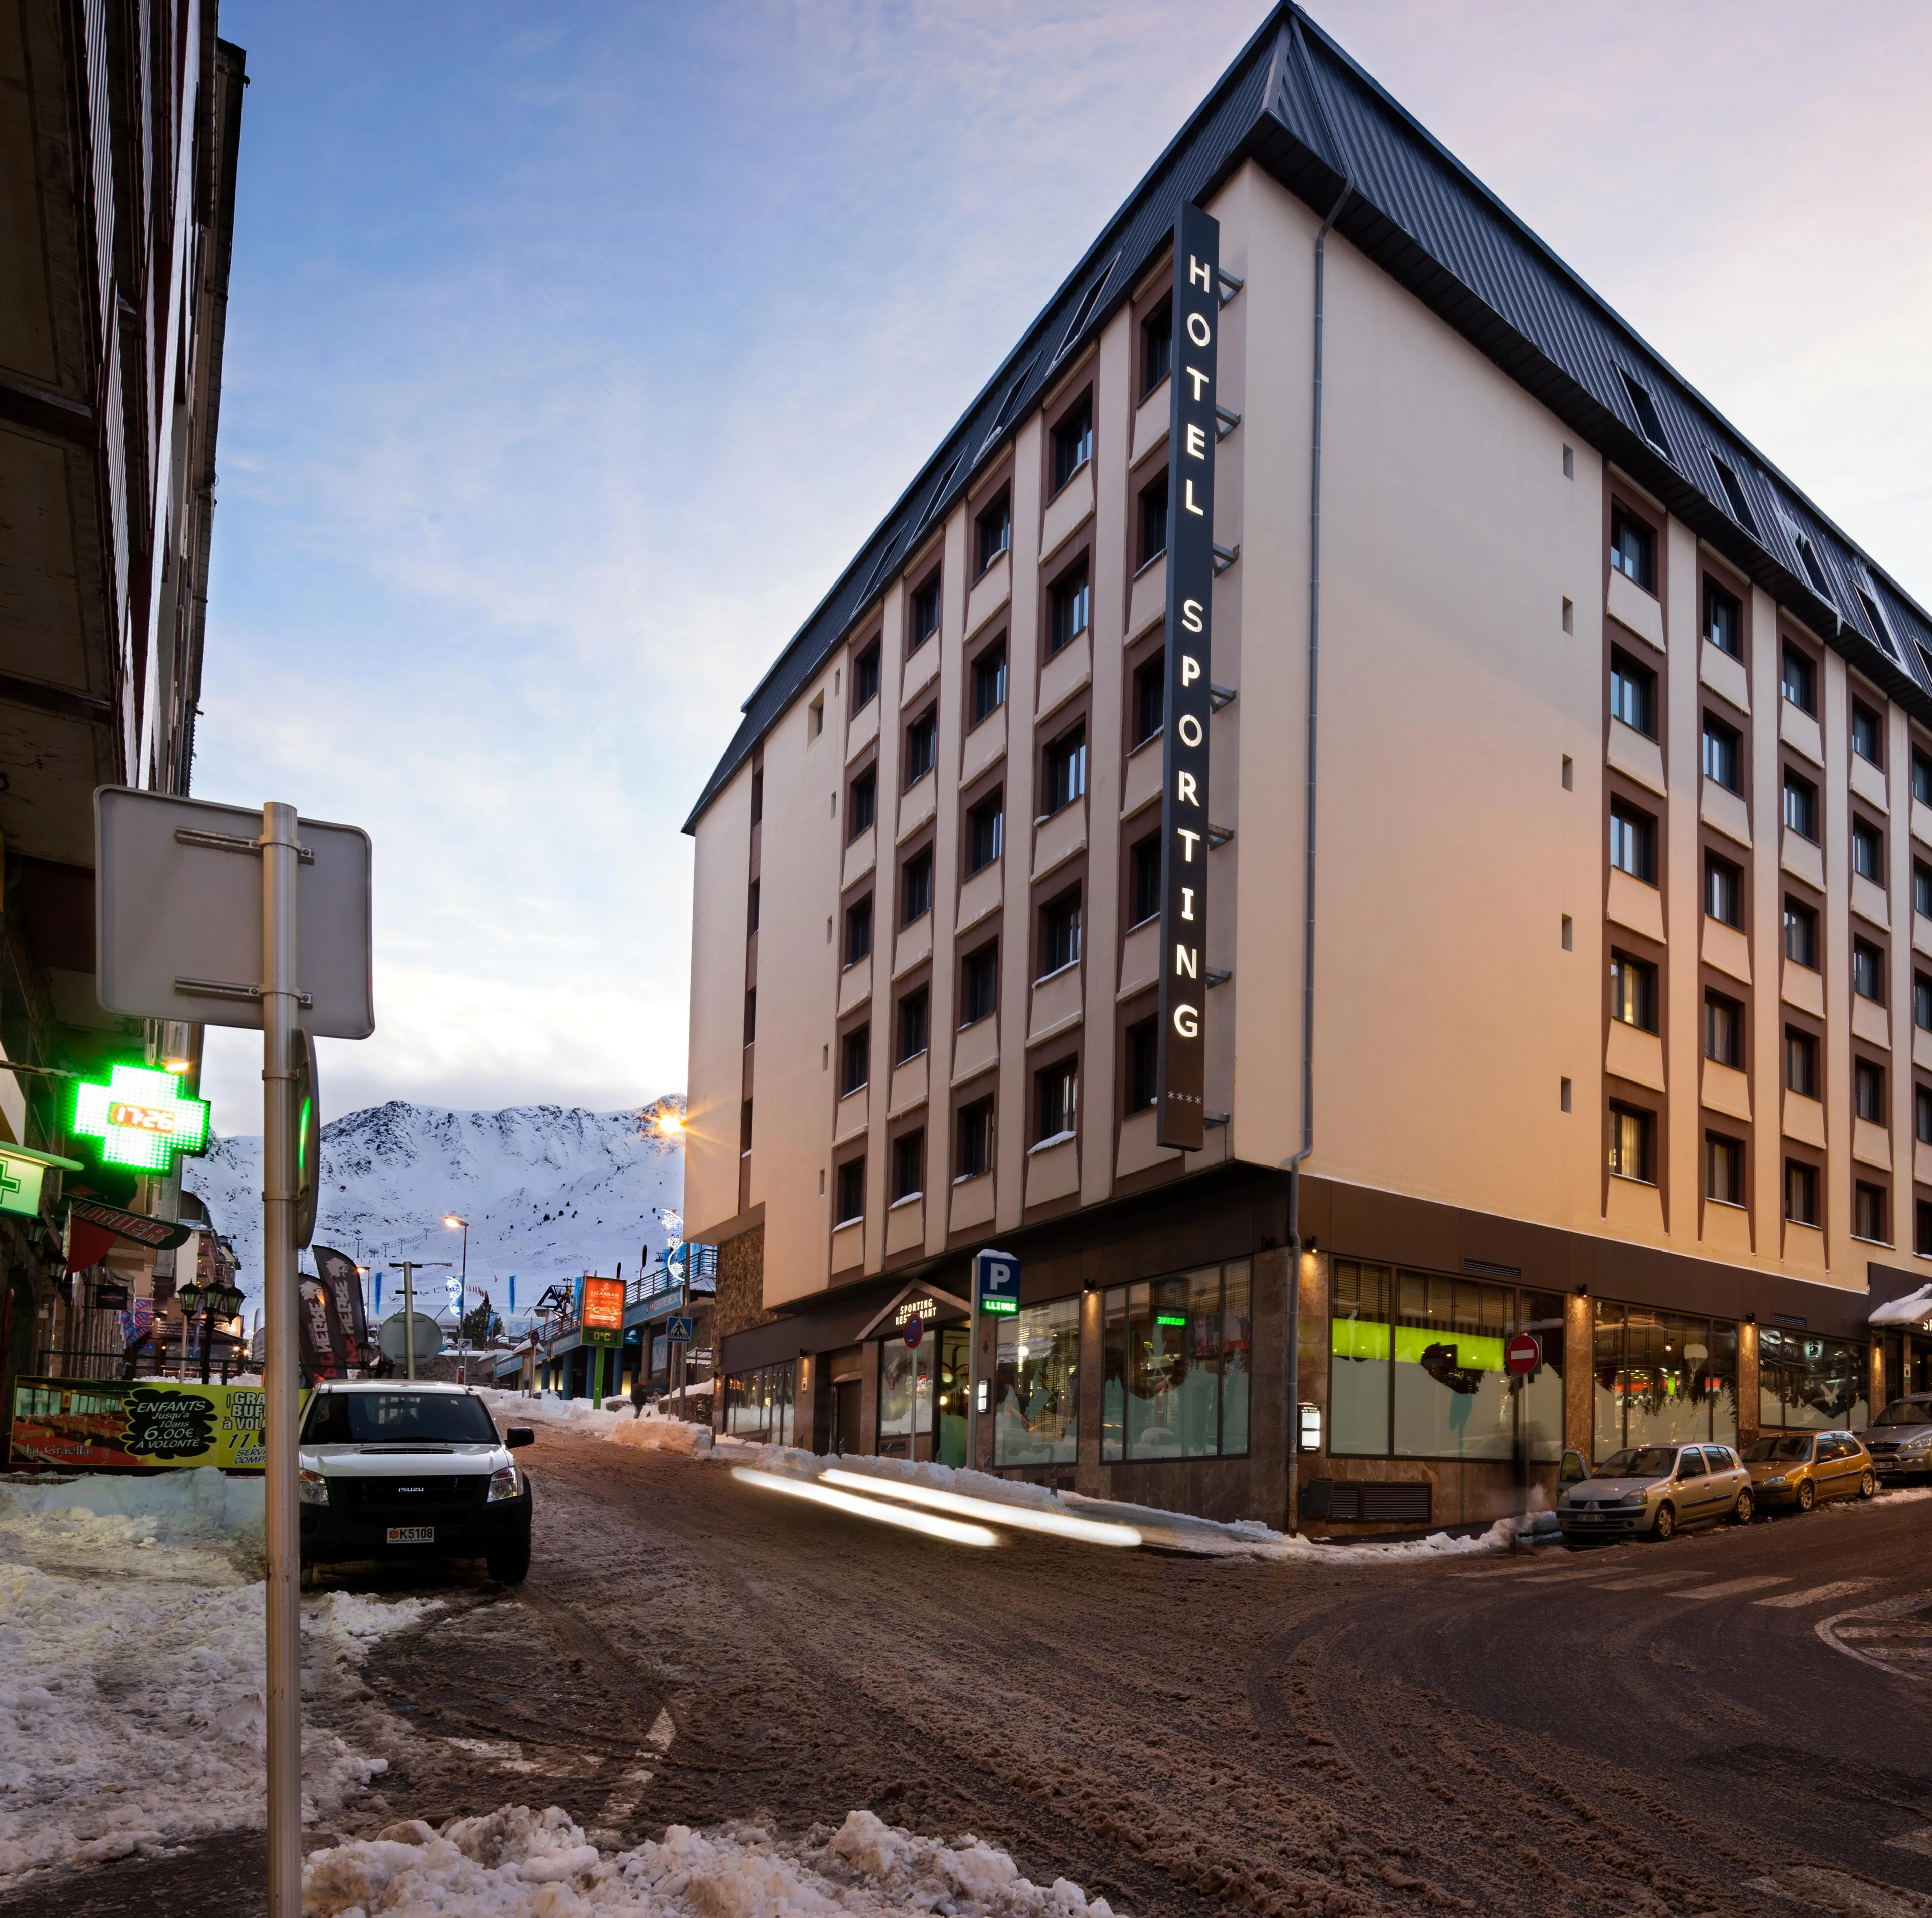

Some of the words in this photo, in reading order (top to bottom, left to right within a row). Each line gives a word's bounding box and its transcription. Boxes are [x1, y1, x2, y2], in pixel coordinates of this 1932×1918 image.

[1186, 254, 1211, 516] HOTEL
[1174, 599, 1203, 1037] SPORTING
[71, 1201, 174, 1245] LLOGUER
[990, 1263, 1011, 1290] P
[900, 1298, 933, 1315] SPORTING
[594, 1332, 611, 1341] 0°C
[137, 1401, 206, 1412] ENFANTS
[223, 1417, 232, 1430] à
[144, 1426, 194, 1440] 6.00€
[148, 1437, 200, 1448] VOLONTÉ
[26, 1444, 39, 1454] La
[45, 1444, 90, 1455] Graella
[400, 1528, 433, 1539] K5108
